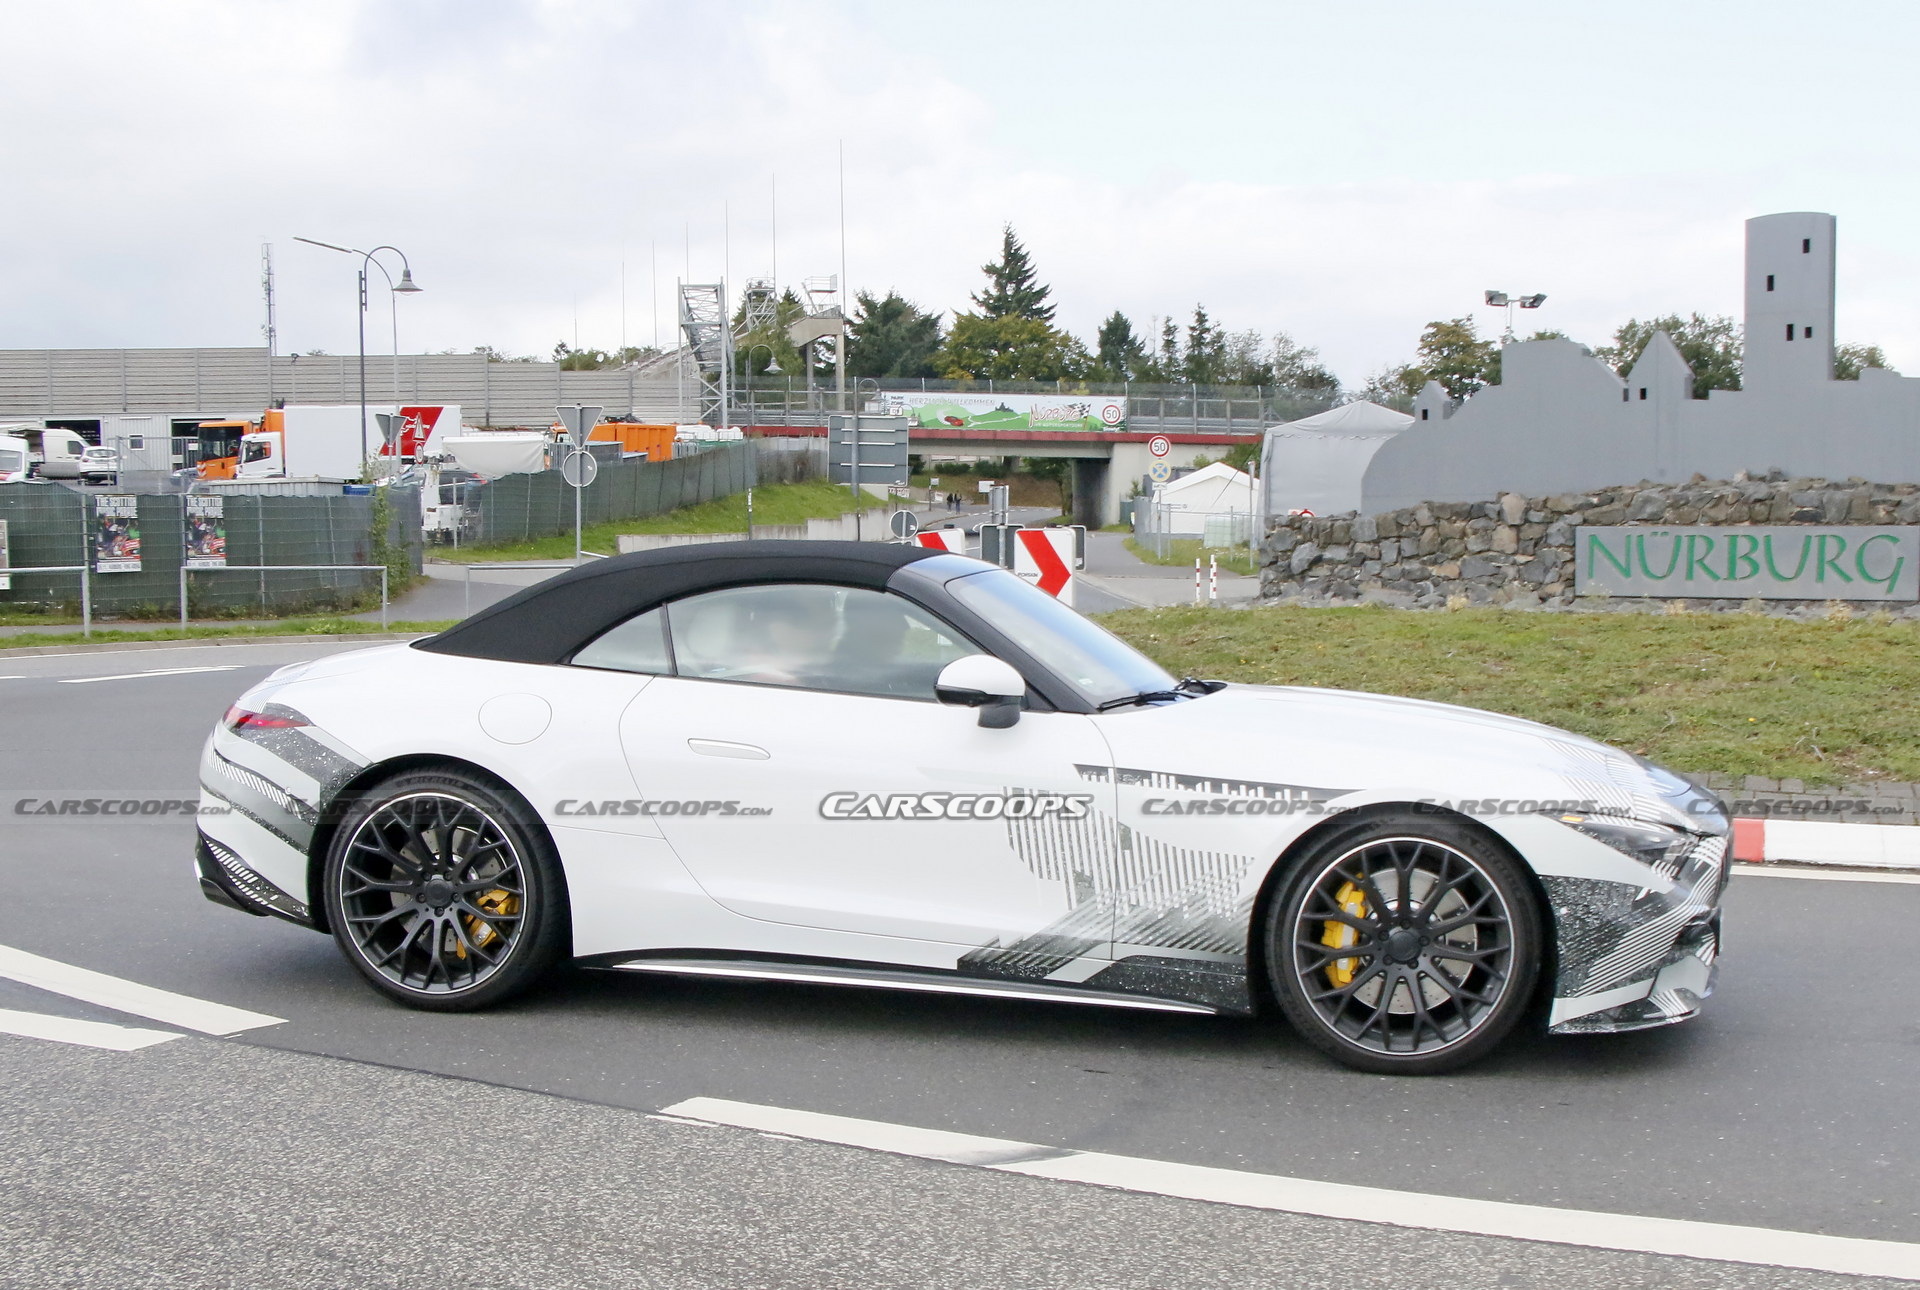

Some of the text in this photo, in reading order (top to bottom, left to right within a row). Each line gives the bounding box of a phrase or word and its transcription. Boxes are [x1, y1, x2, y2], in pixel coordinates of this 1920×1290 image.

[1106, 409, 1117, 419] 50
[1153, 442, 1166, 452] 50
[1588, 531, 1905, 595] NÜRBURG
